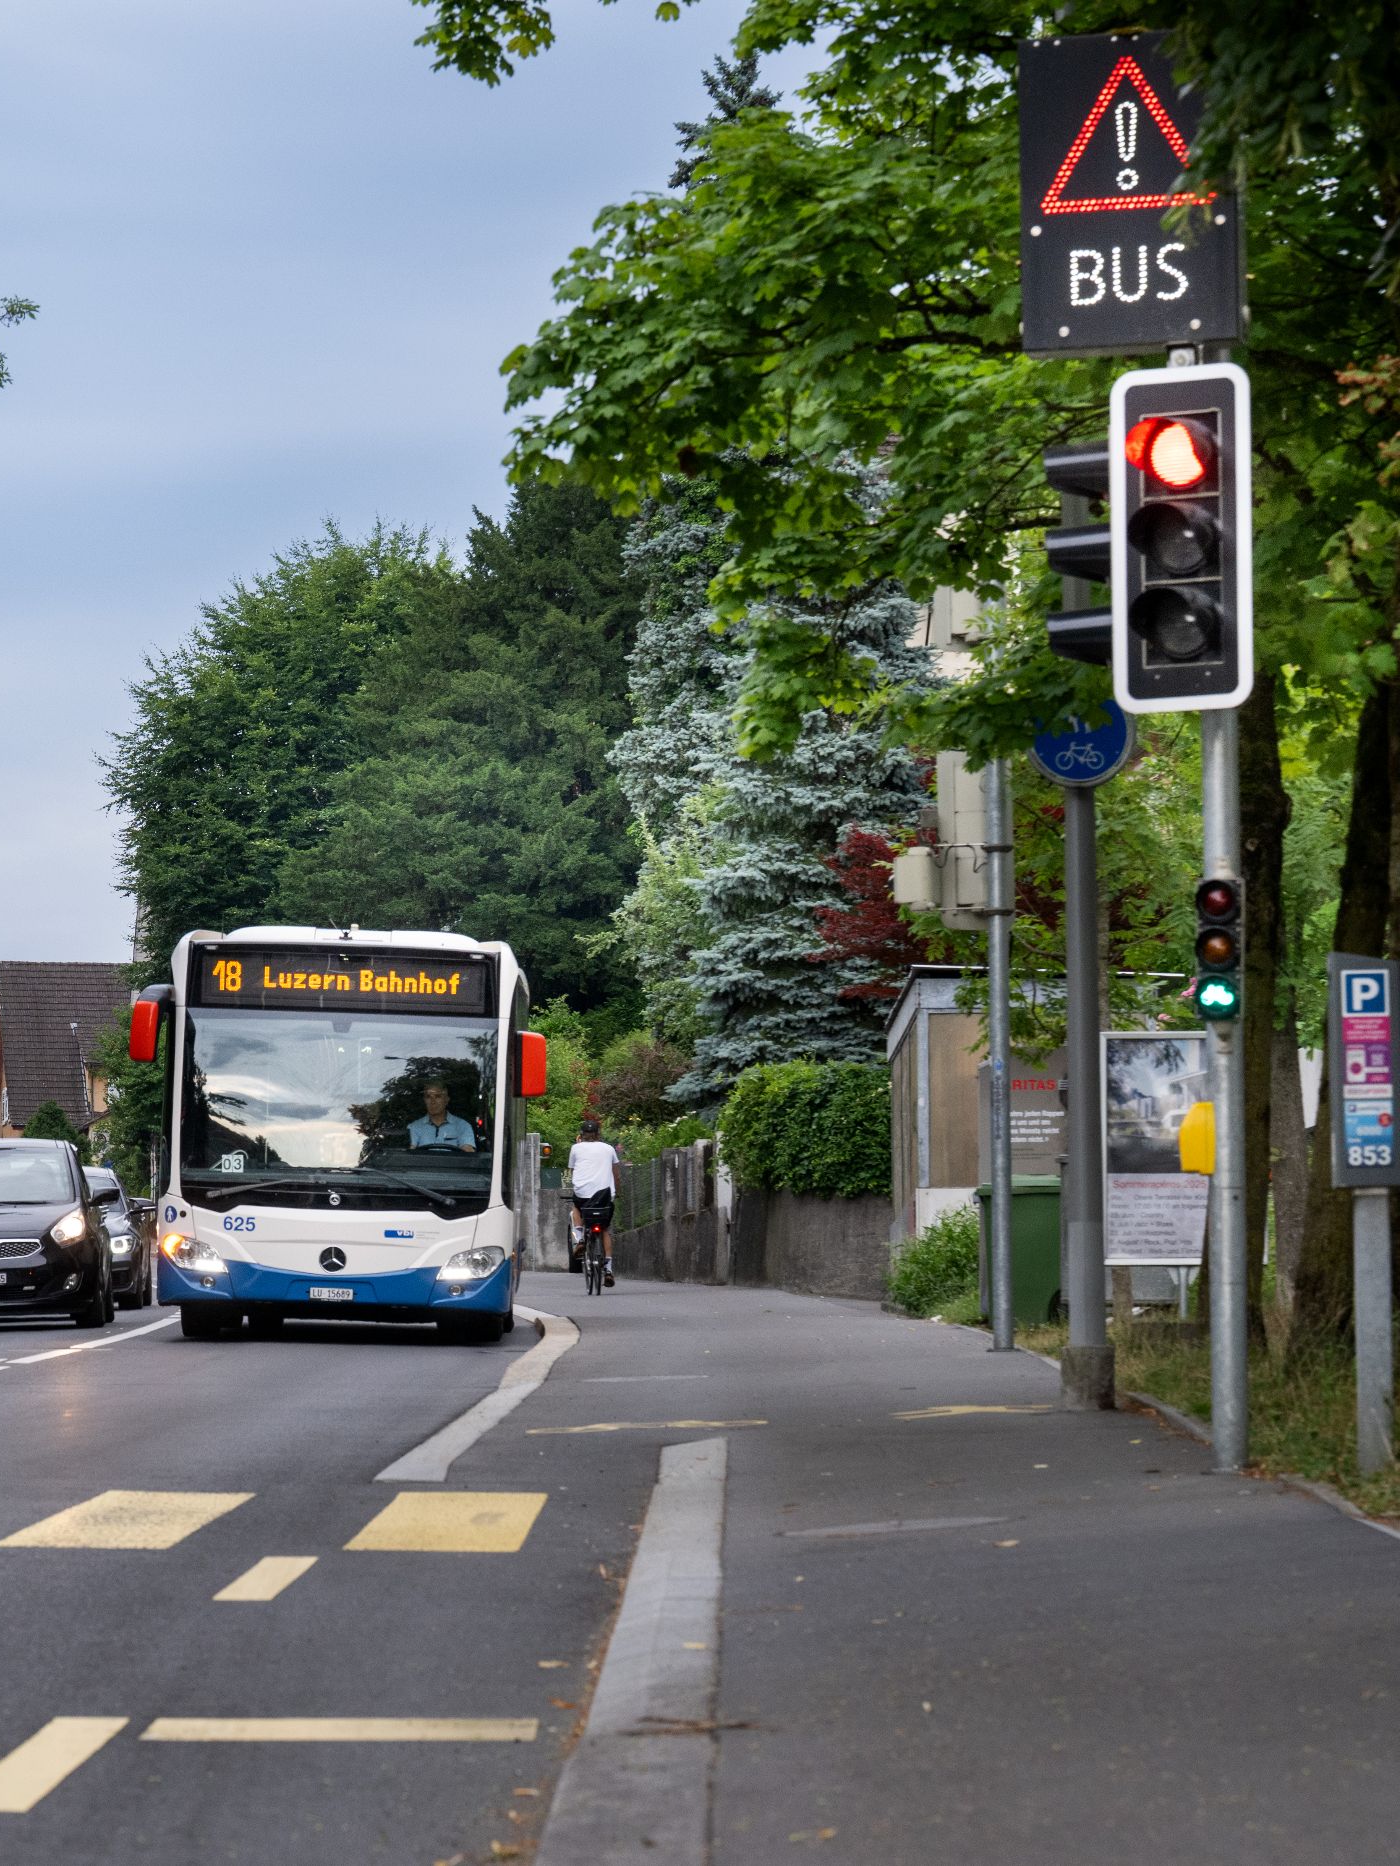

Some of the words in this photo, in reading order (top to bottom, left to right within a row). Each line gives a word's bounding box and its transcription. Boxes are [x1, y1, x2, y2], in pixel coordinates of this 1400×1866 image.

[1070, 243, 1189, 306] BUS
[213, 960, 242, 992] 18
[263, 966, 350, 991] Luzern
[359, 969, 460, 995] Bahnhof
[1351, 977, 1380, 1012] P
[1011, 1079, 1056, 1091] RITAS
[223, 1158, 242, 1171] 03
[1348, 1145, 1392, 1166] 853
[223, 1216, 256, 1231] 625
[312, 1289, 323, 1298] LU
[327, 1290, 351, 1299] 15689
